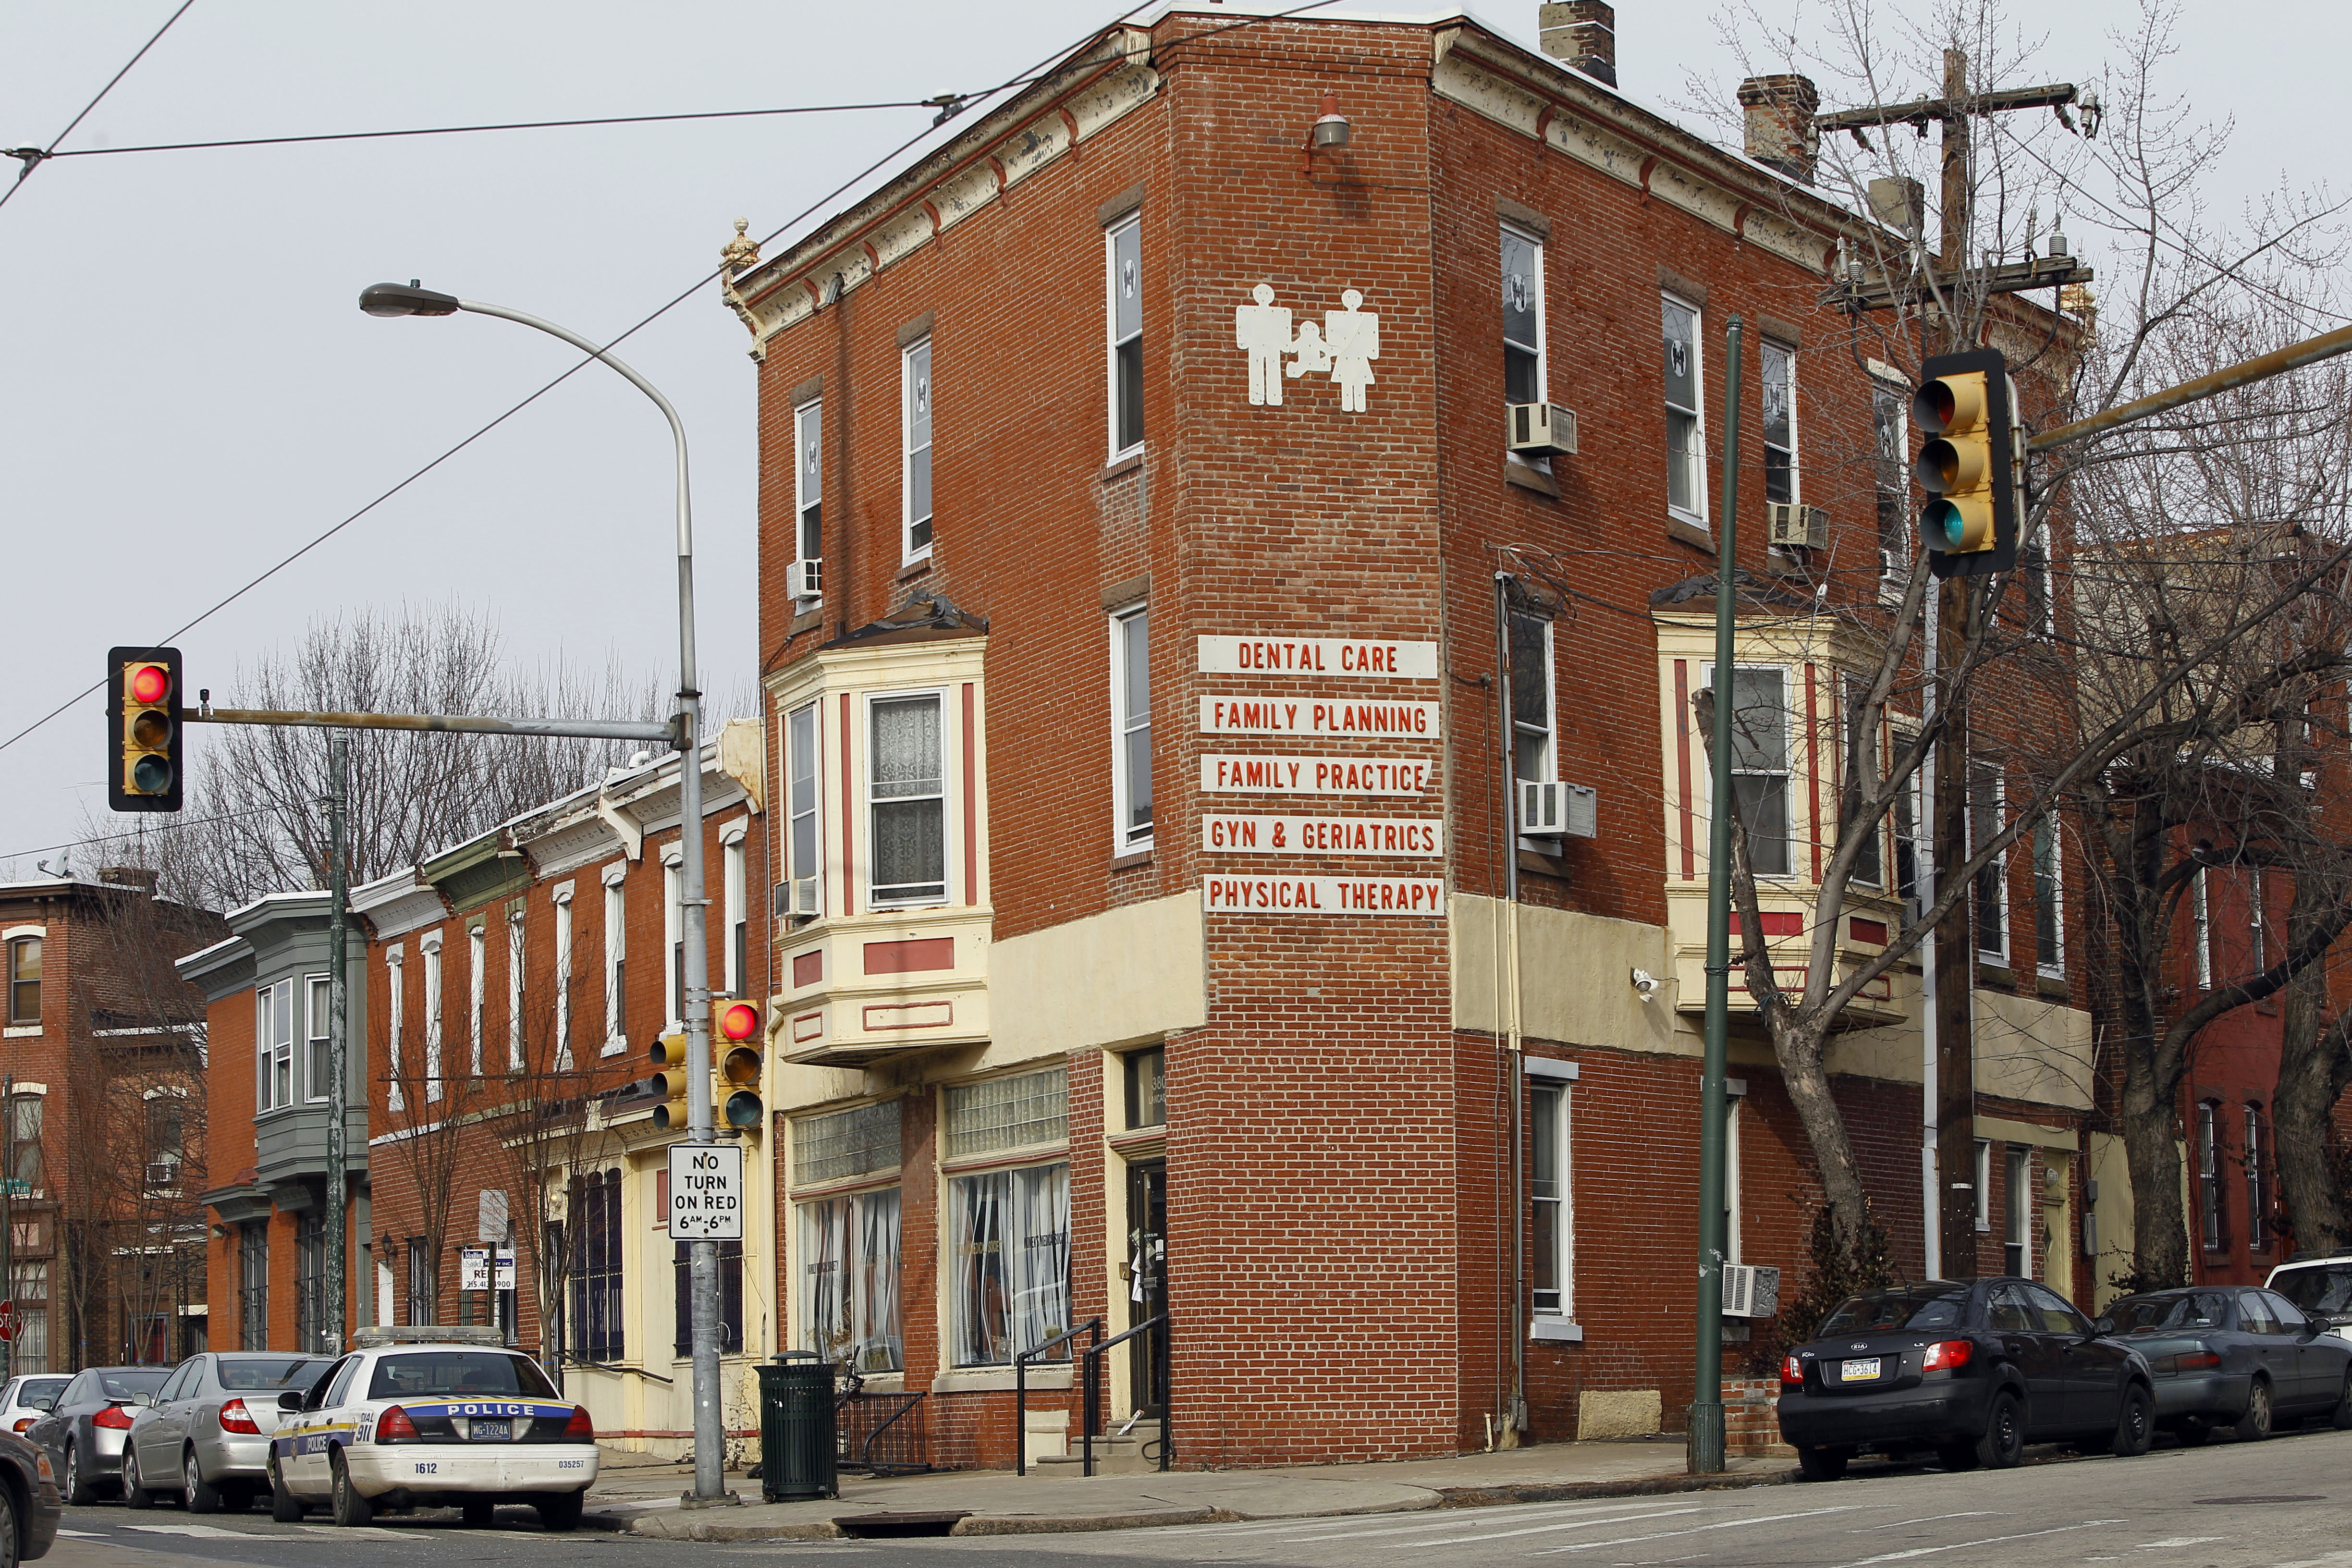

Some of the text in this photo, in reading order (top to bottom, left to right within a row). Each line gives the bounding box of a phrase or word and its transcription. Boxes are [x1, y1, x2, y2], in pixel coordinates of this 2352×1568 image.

[1239, 642, 1397, 672] DENTAL CARE
[1214, 702, 1426, 732] FAMILY PLANNING
[1217, 761, 1424, 791] FAMILY PRACTICE
[1212, 821, 1434, 851] GYN & GERIATRICS
[1210, 880, 1438, 910] PHYSICAL THERAPY
[693, 1156, 719, 1169] NO
[685, 1176, 727, 1189] TURN
[675, 1195, 736, 1209] ON RED
[474, 1270, 502, 1278] RET
[447, 1404, 534, 1415] POLICE
[361, 1412, 373, 1422] DIAL
[356, 1424, 372, 1442] 911
[473, 1425, 508, 1435] MG-1224A
[307, 1435, 327, 1452] POLICE
[415, 1463, 437, 1474] 1612
[559, 1460, 585, 1469] 035257
